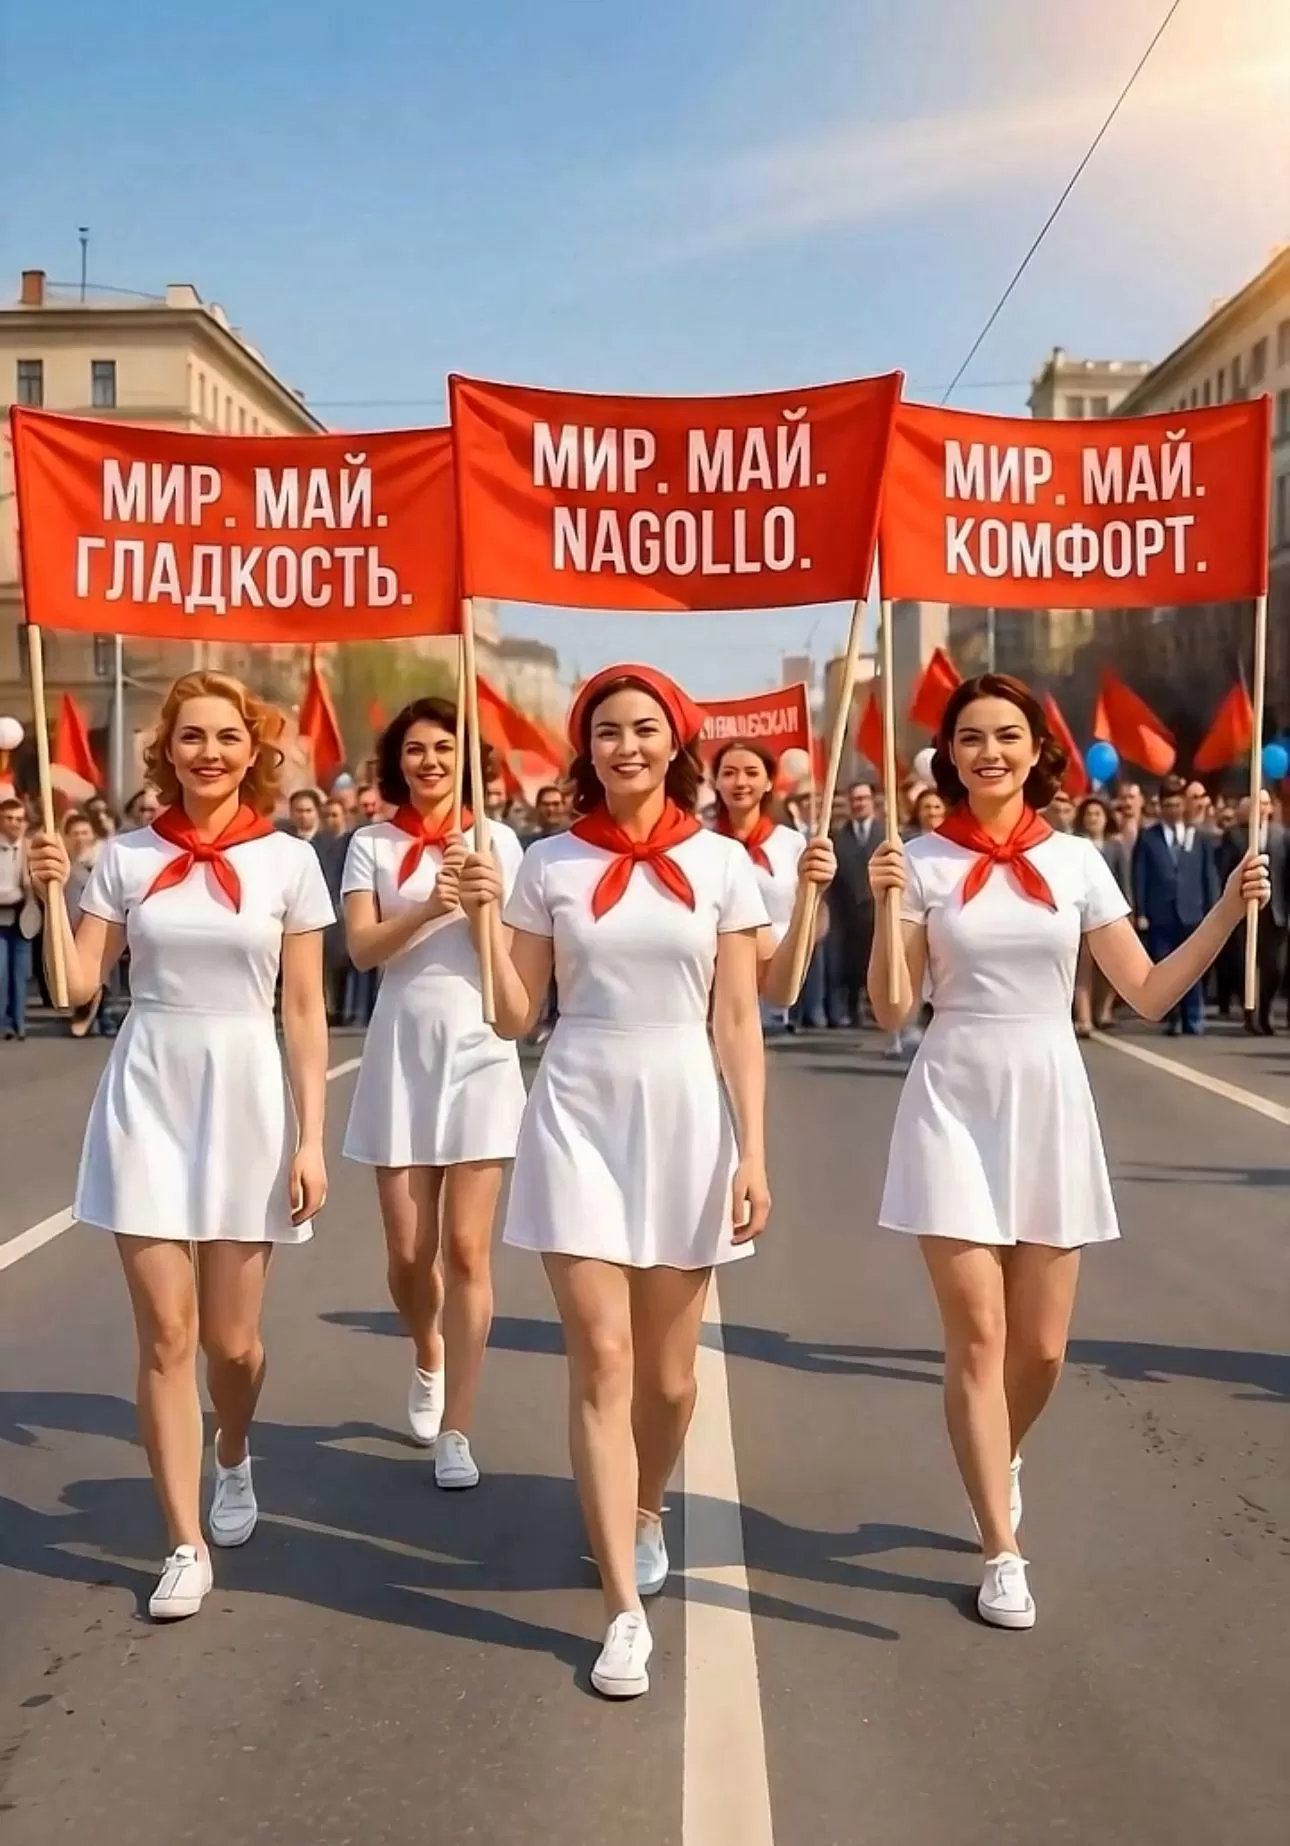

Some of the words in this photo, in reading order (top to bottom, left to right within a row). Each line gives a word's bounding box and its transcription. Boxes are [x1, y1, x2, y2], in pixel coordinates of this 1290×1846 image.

[533, 422, 669, 494] МИР.
[688, 406, 827, 494] МАЙ.
[944, 440, 1066, 505] МИР.
[1082, 428, 1206, 505] МАЙ.
[103, 459, 236, 528] МИР.
[255, 452, 388, 529] МАЙ.
[75, 536, 413, 615] ГЛАДКОСТЬ.
[553, 506, 812, 575] NAGOLLO.
[945, 515, 1208, 579] КОМФОРТ.
